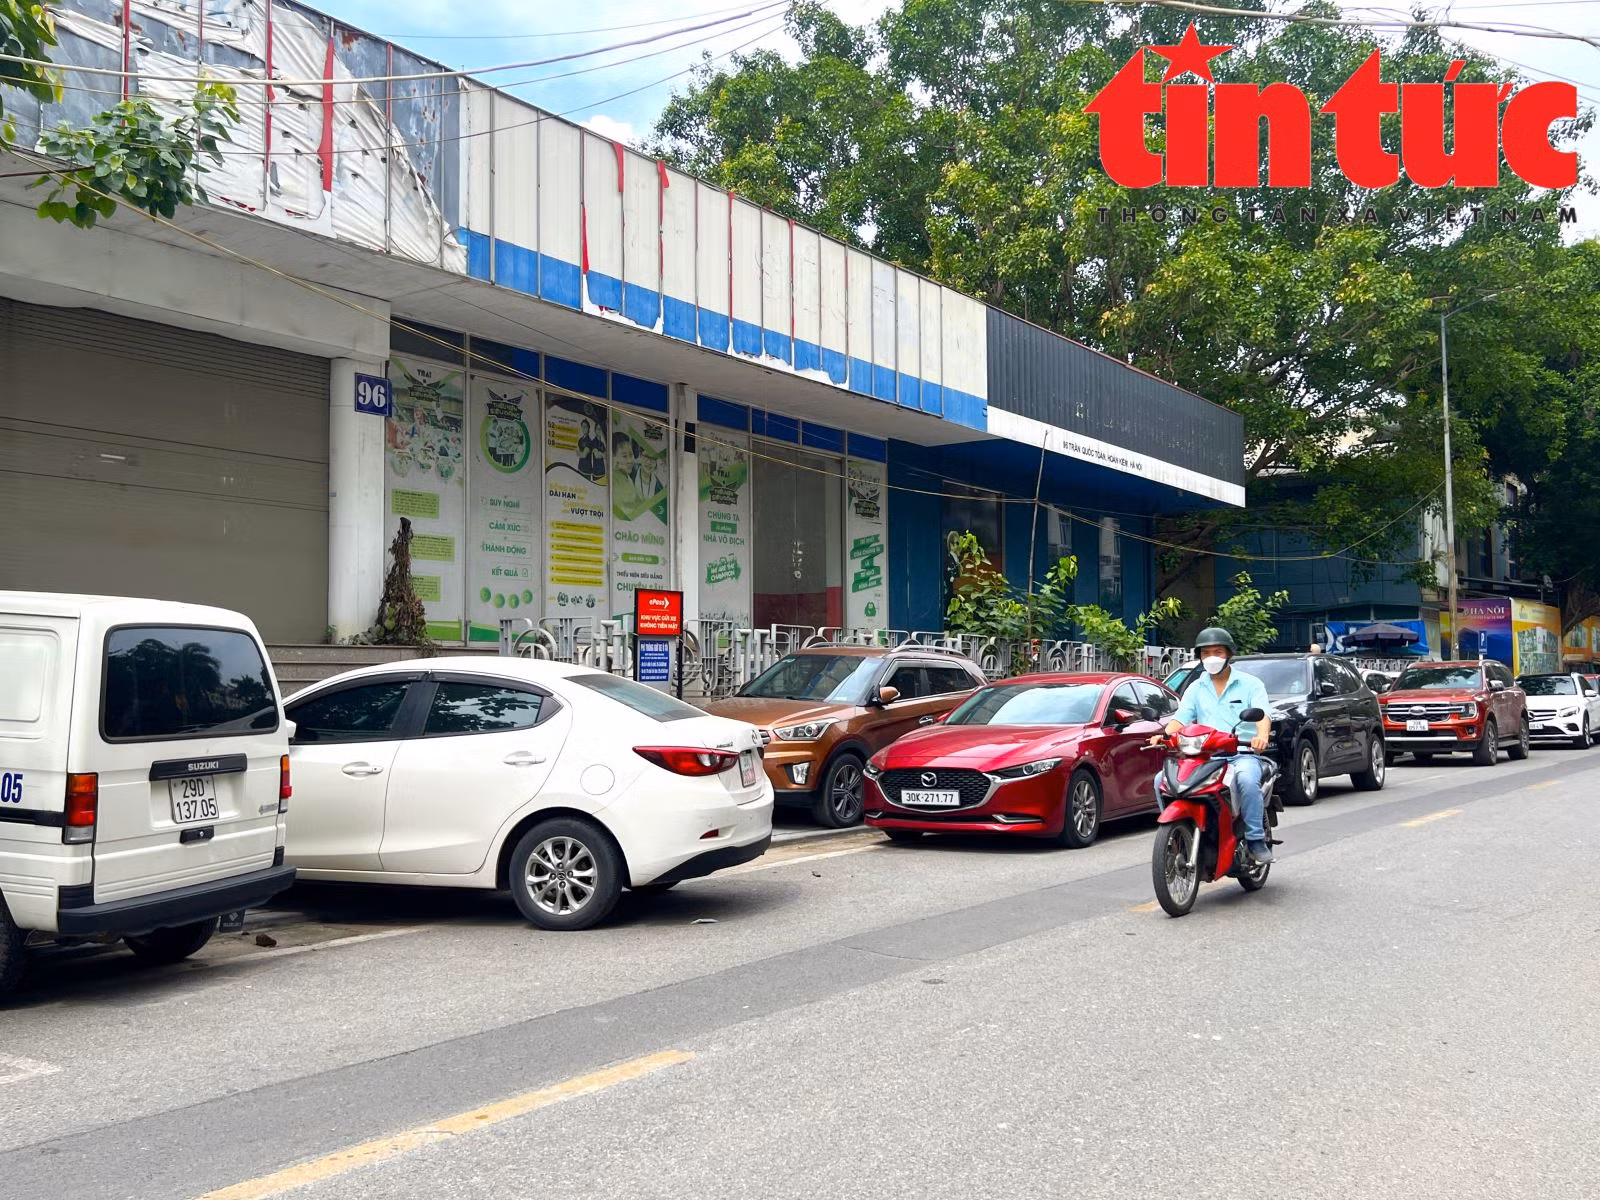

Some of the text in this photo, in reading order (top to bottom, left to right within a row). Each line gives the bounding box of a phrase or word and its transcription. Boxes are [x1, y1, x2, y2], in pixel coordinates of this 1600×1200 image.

[358, 382, 385, 407] 96
[490, 498, 502, 506] SUY
[188, 761, 219, 771] SUZUKI
[1, 772, 23, 803] 05
[181, 778, 205, 798] 29D
[906, 793, 954, 803] 30K-271.77
[176, 798, 217, 820] 137.05
